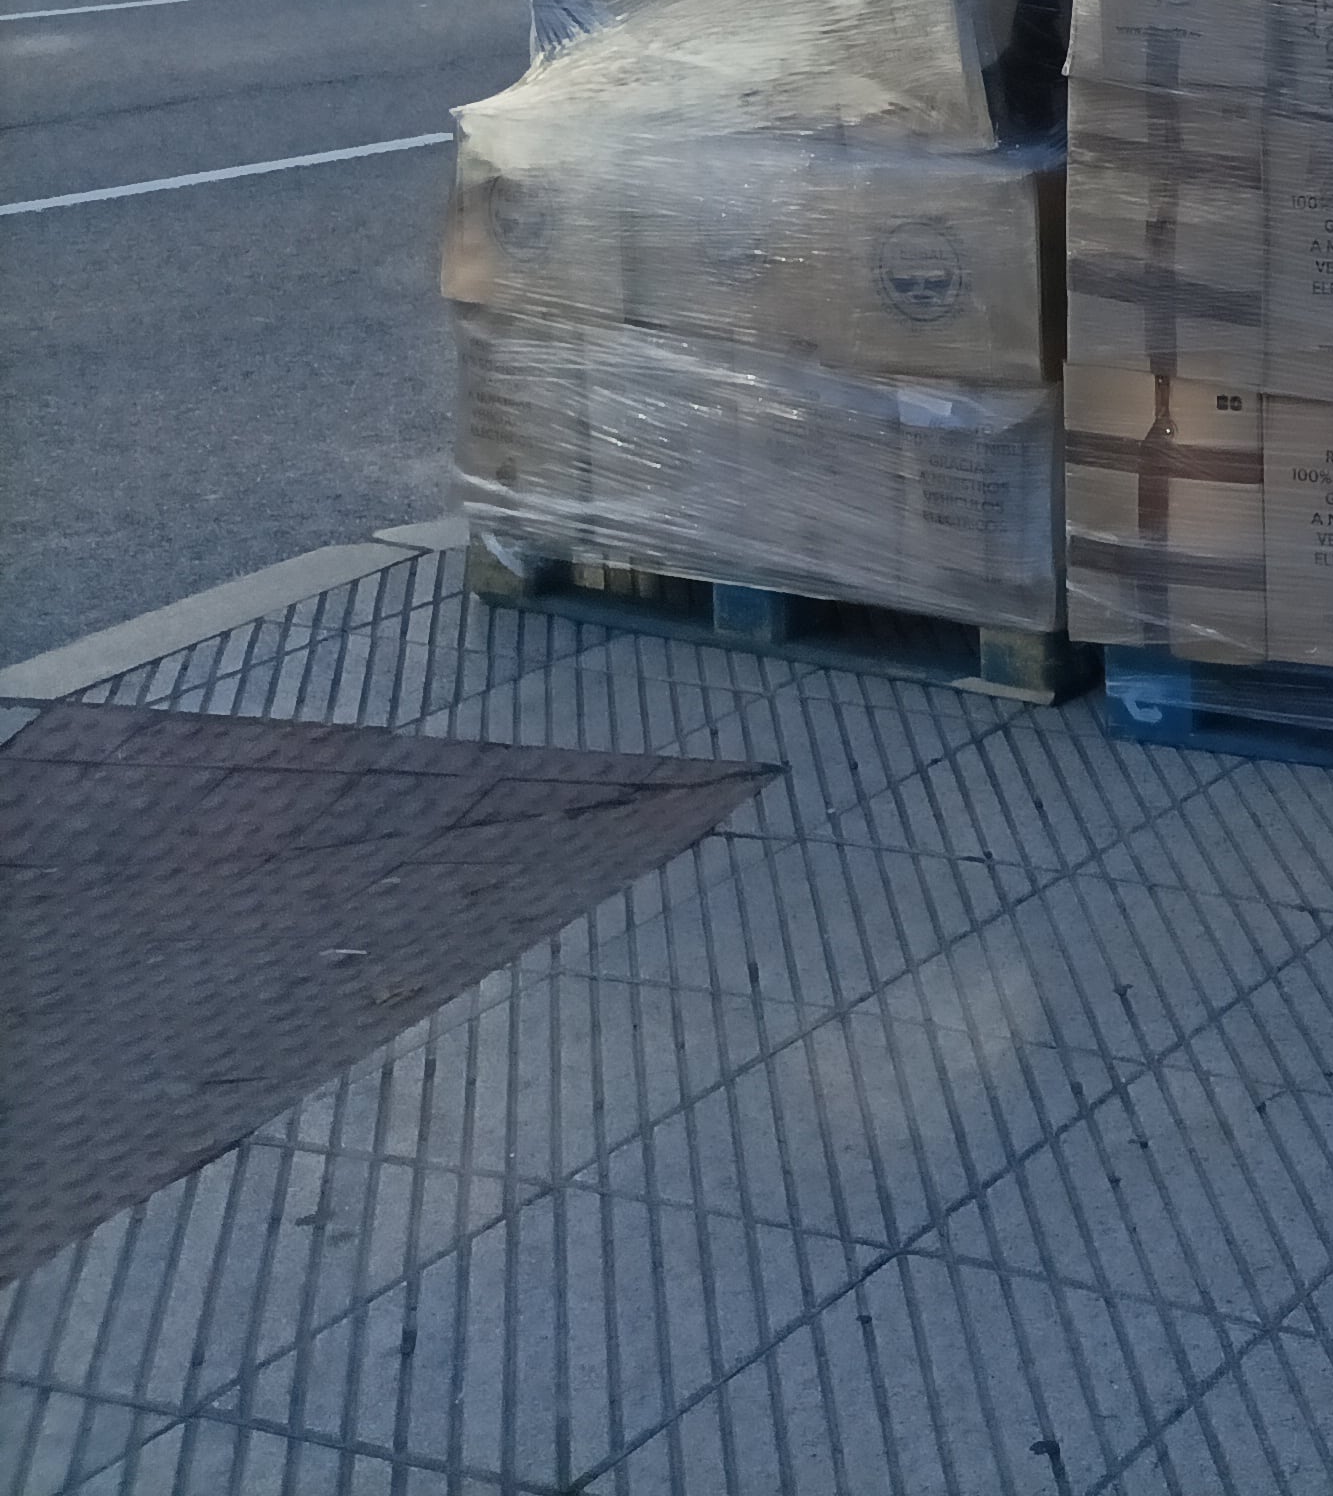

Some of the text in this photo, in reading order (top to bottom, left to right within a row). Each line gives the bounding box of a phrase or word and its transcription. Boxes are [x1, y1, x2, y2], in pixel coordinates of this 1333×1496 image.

[1310, 240, 1322, 253] A
[1292, 468, 1332, 484] 100%
[1311, 512, 1323, 526] A
